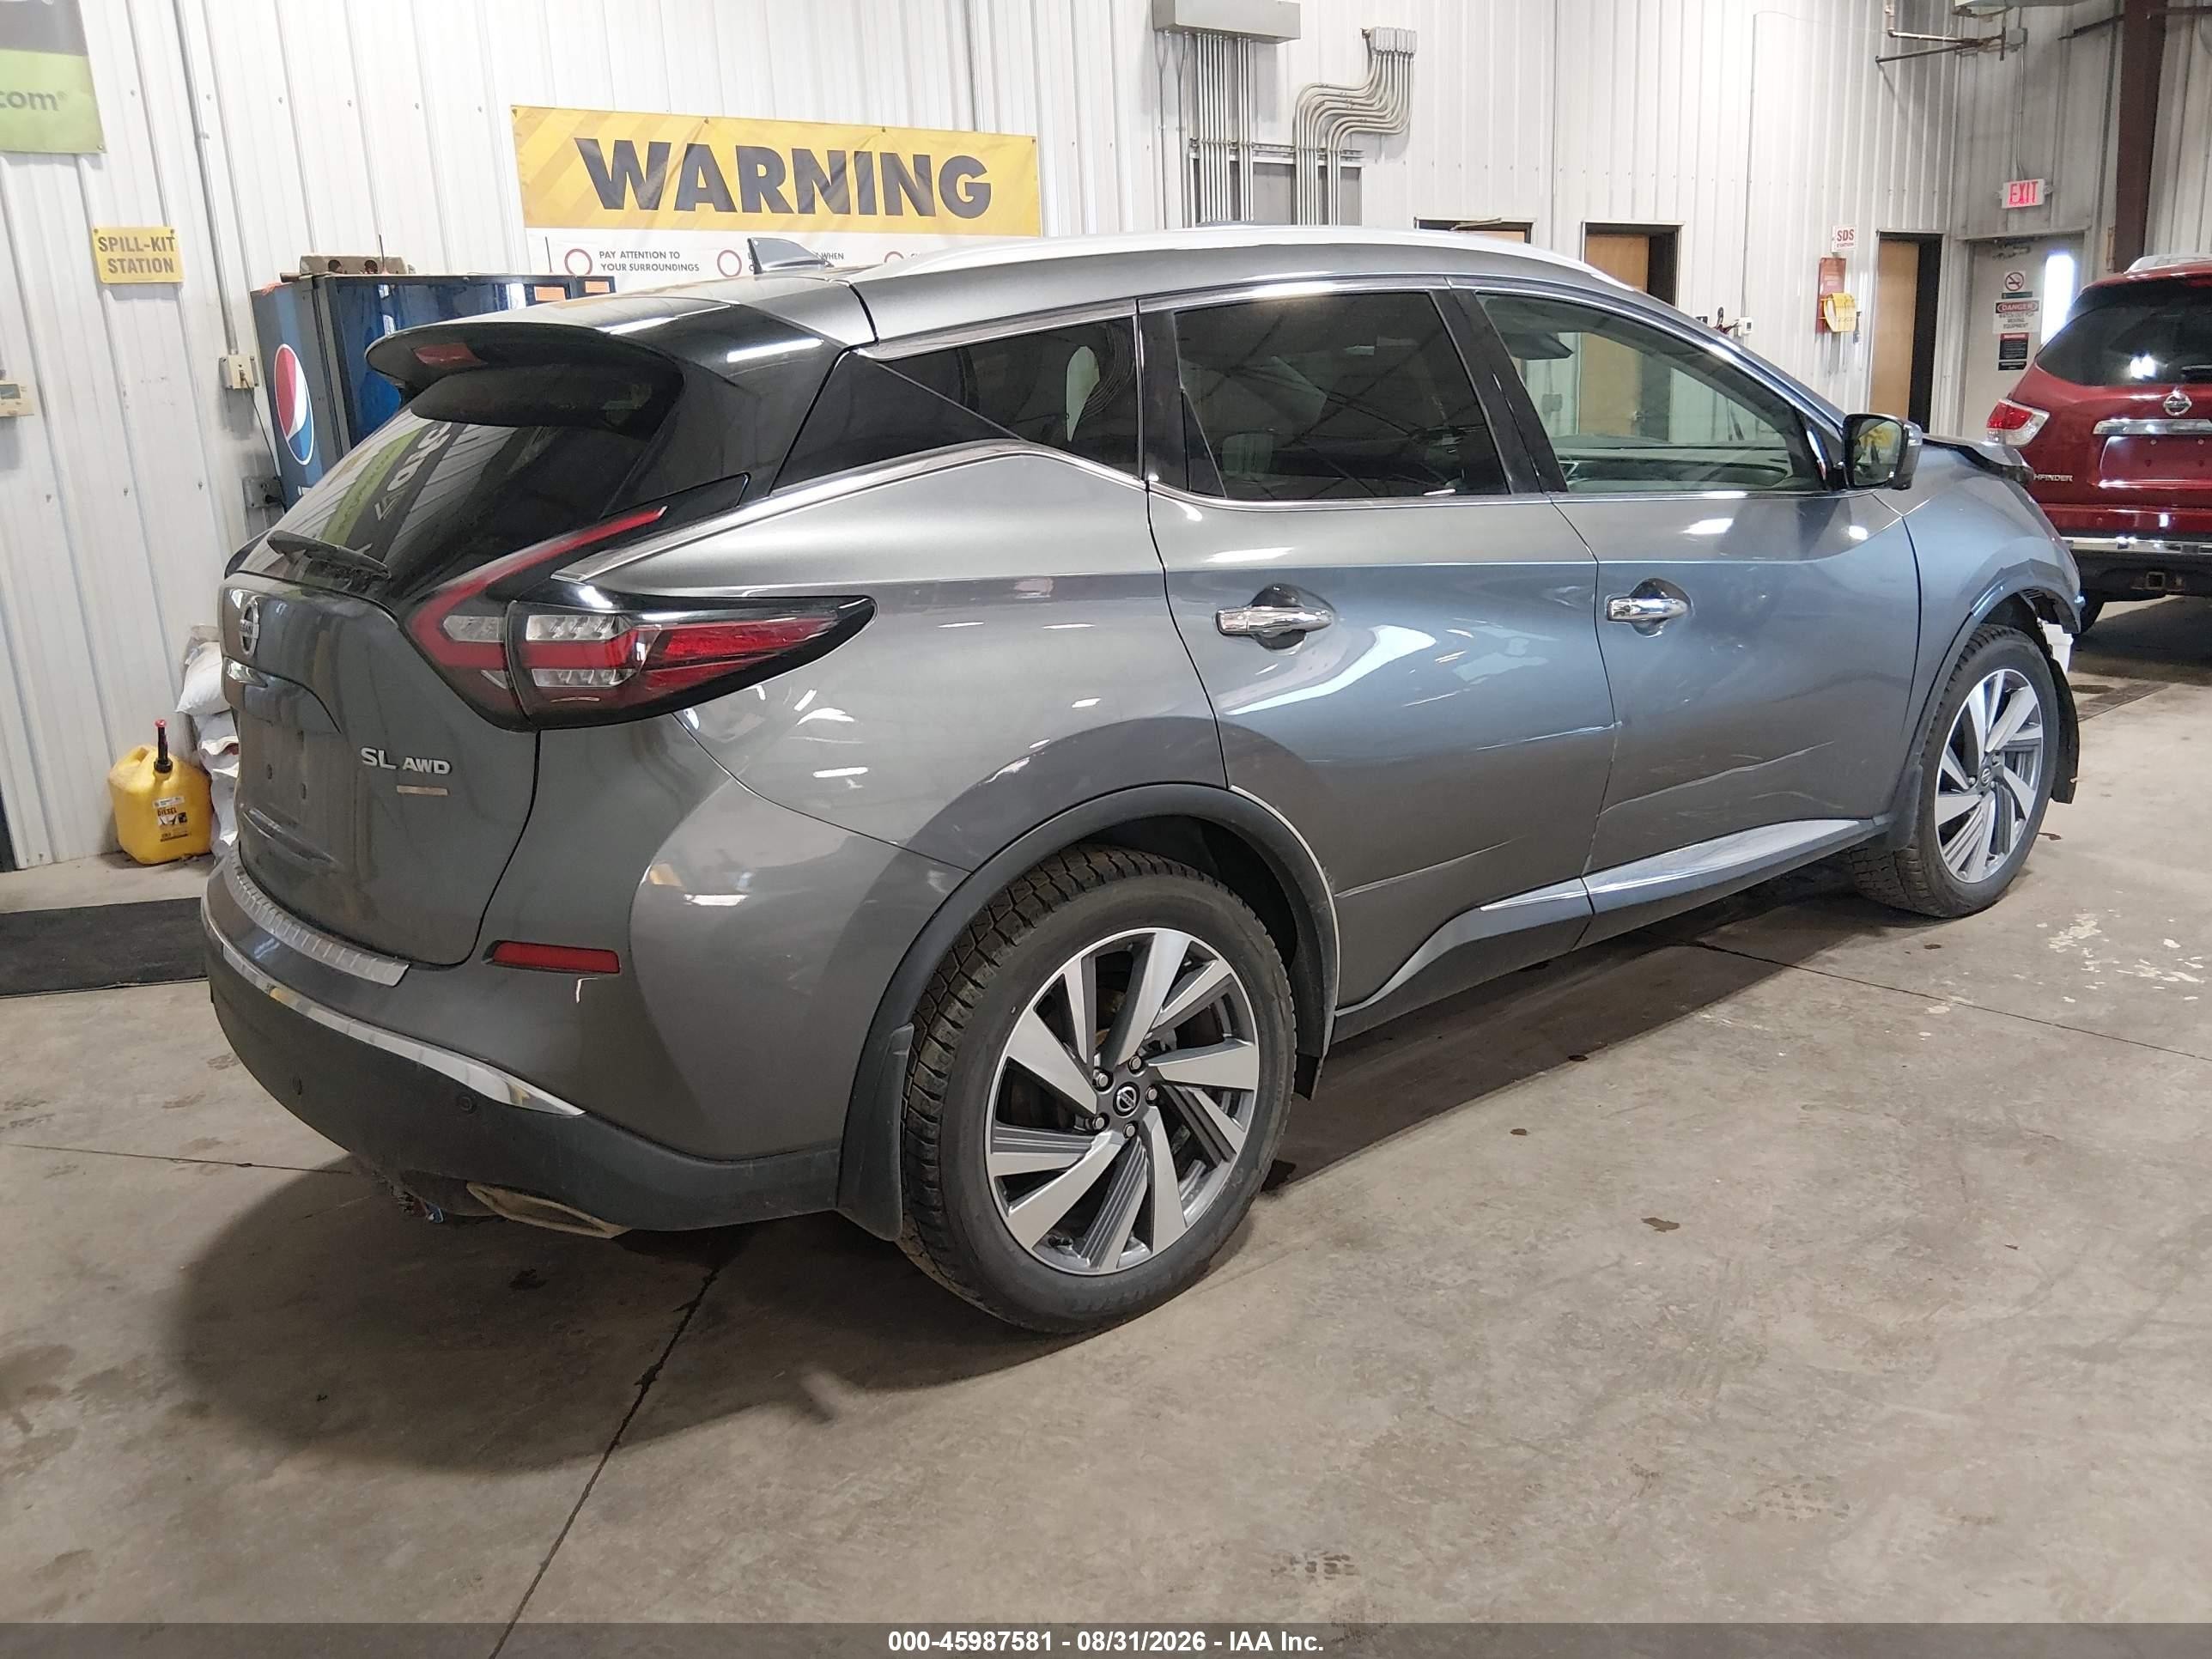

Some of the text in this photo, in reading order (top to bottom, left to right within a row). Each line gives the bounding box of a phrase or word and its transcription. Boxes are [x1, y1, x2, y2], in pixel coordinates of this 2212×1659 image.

[574, 137, 992, 219] WARNING
[2009, 180, 2039, 205] EXIT
[1837, 228, 1855, 241] SDS
[98, 236, 175, 252] SPILL-KIT
[599, 251, 680, 259] PAY ATTENTION TO
[107, 258, 174, 274] STATION
[600, 263, 700, 272] YOUR SURROUNDINGS
[361, 747, 452, 775] SL AWD
